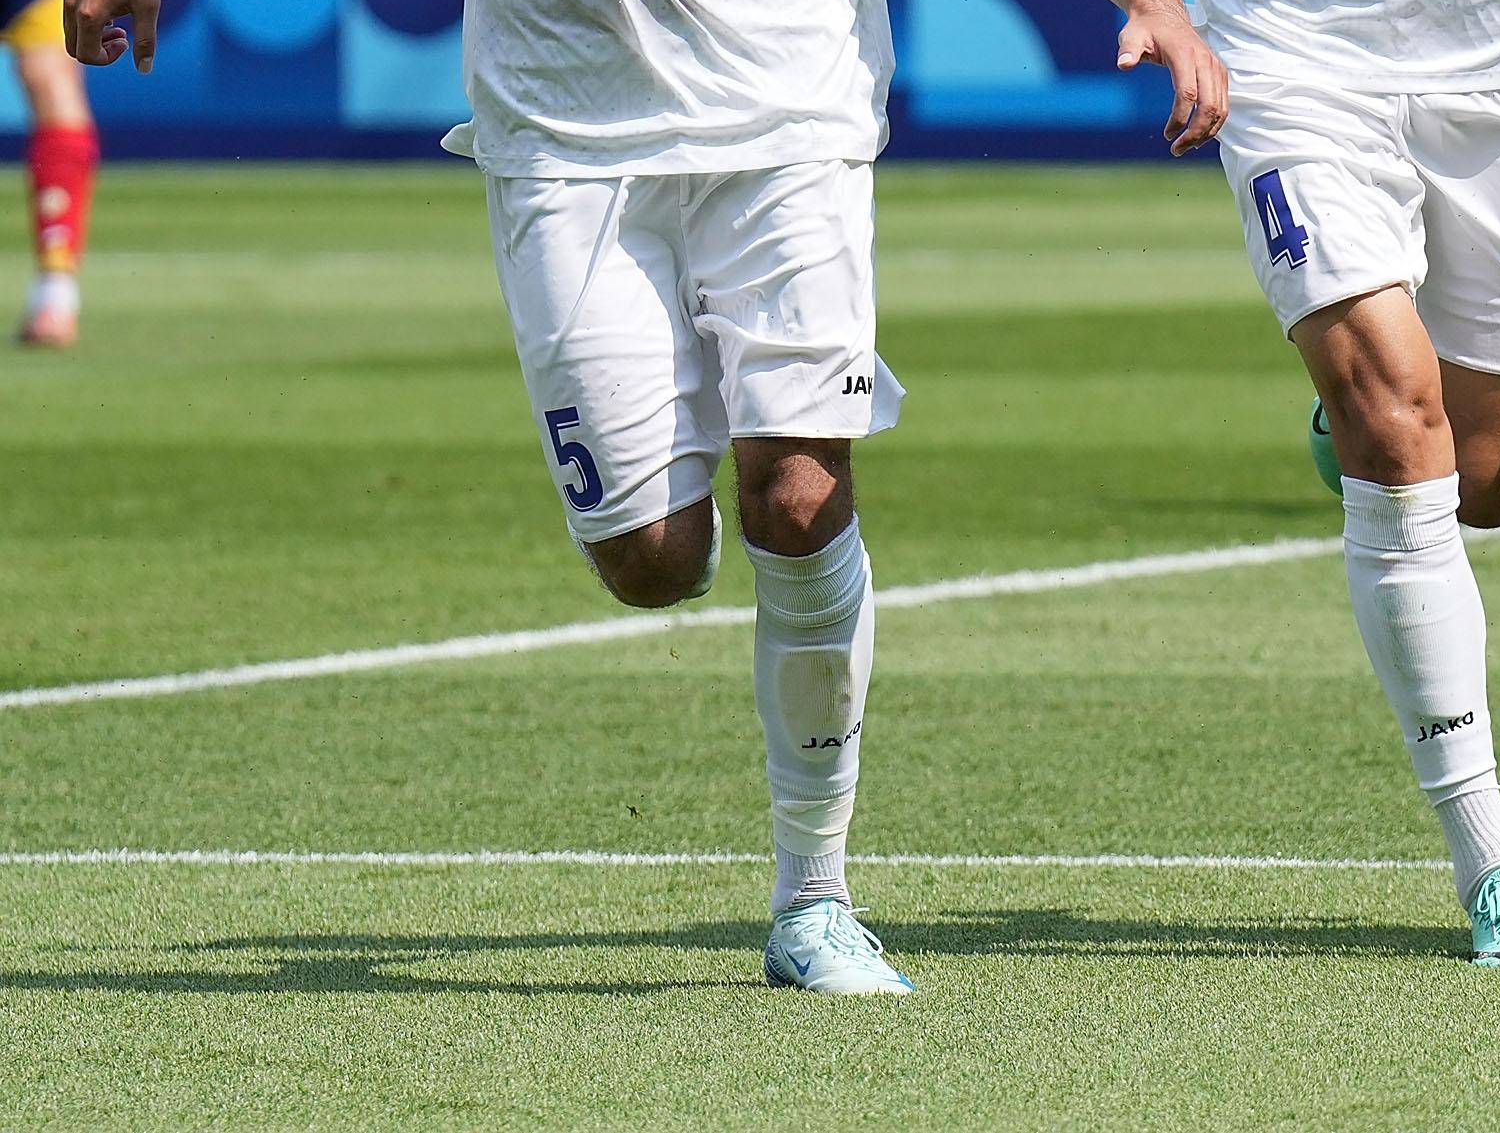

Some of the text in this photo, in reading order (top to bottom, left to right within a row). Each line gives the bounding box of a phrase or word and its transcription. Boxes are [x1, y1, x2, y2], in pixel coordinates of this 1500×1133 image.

[1249, 167, 1310, 270] 4
[544, 405, 604, 513] 5
[1416, 711, 1474, 743] JAKO
